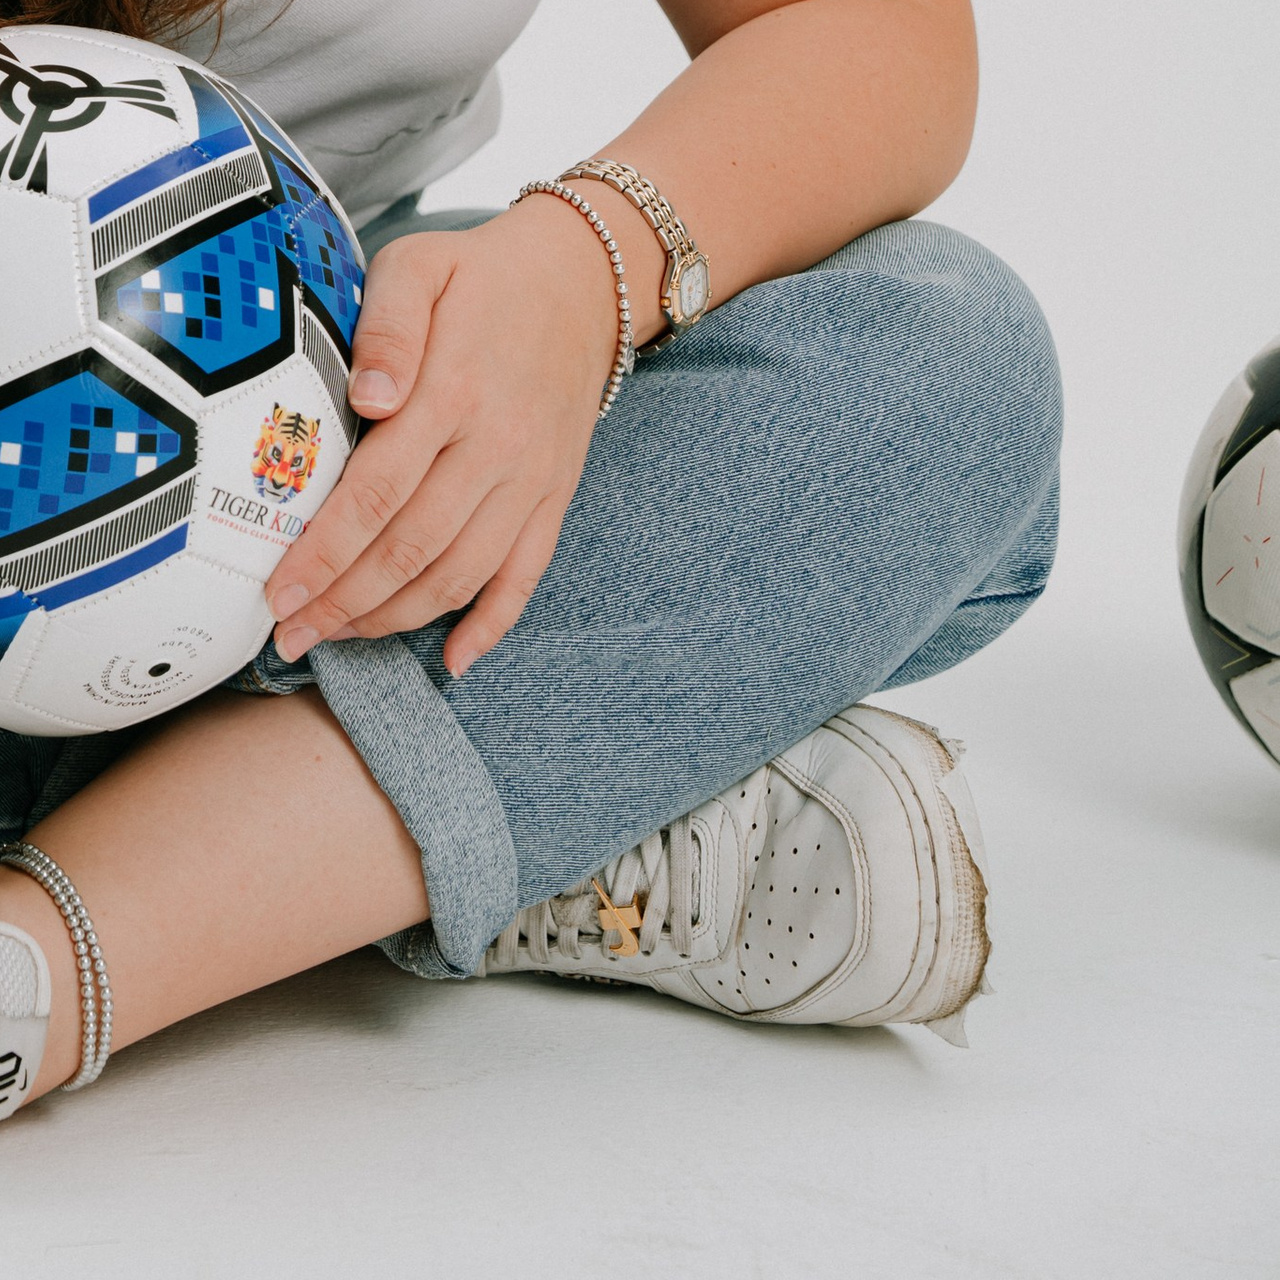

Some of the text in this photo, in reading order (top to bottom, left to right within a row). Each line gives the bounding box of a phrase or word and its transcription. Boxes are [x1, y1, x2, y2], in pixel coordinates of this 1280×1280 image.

[208, 487, 269, 527] TIGER
[206, 513, 249, 534] FOOTBALL
[250, 529, 270, 542] CLUB
[115, 699, 149, 707] MADE
